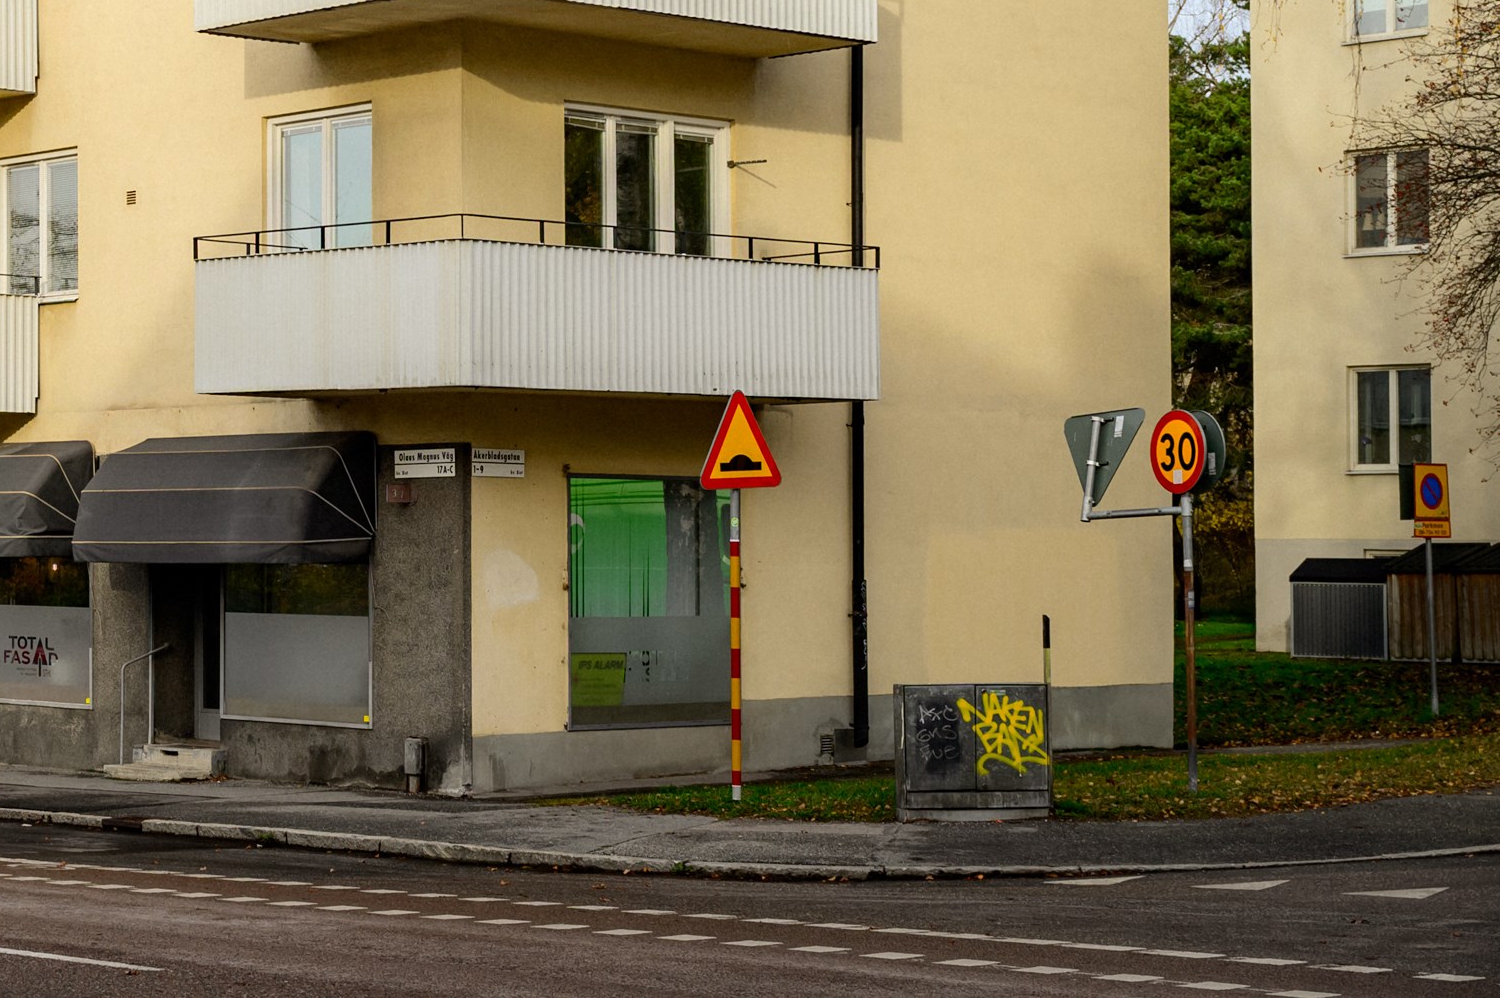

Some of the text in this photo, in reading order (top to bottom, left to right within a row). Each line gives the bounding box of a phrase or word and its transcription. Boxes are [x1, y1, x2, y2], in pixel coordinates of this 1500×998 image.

[417, 452, 440, 462] Magnus
[1160, 432, 1197, 472] 30
[9, 636, 54, 650] TOTAL
[593, 660, 624, 670] ALARM
